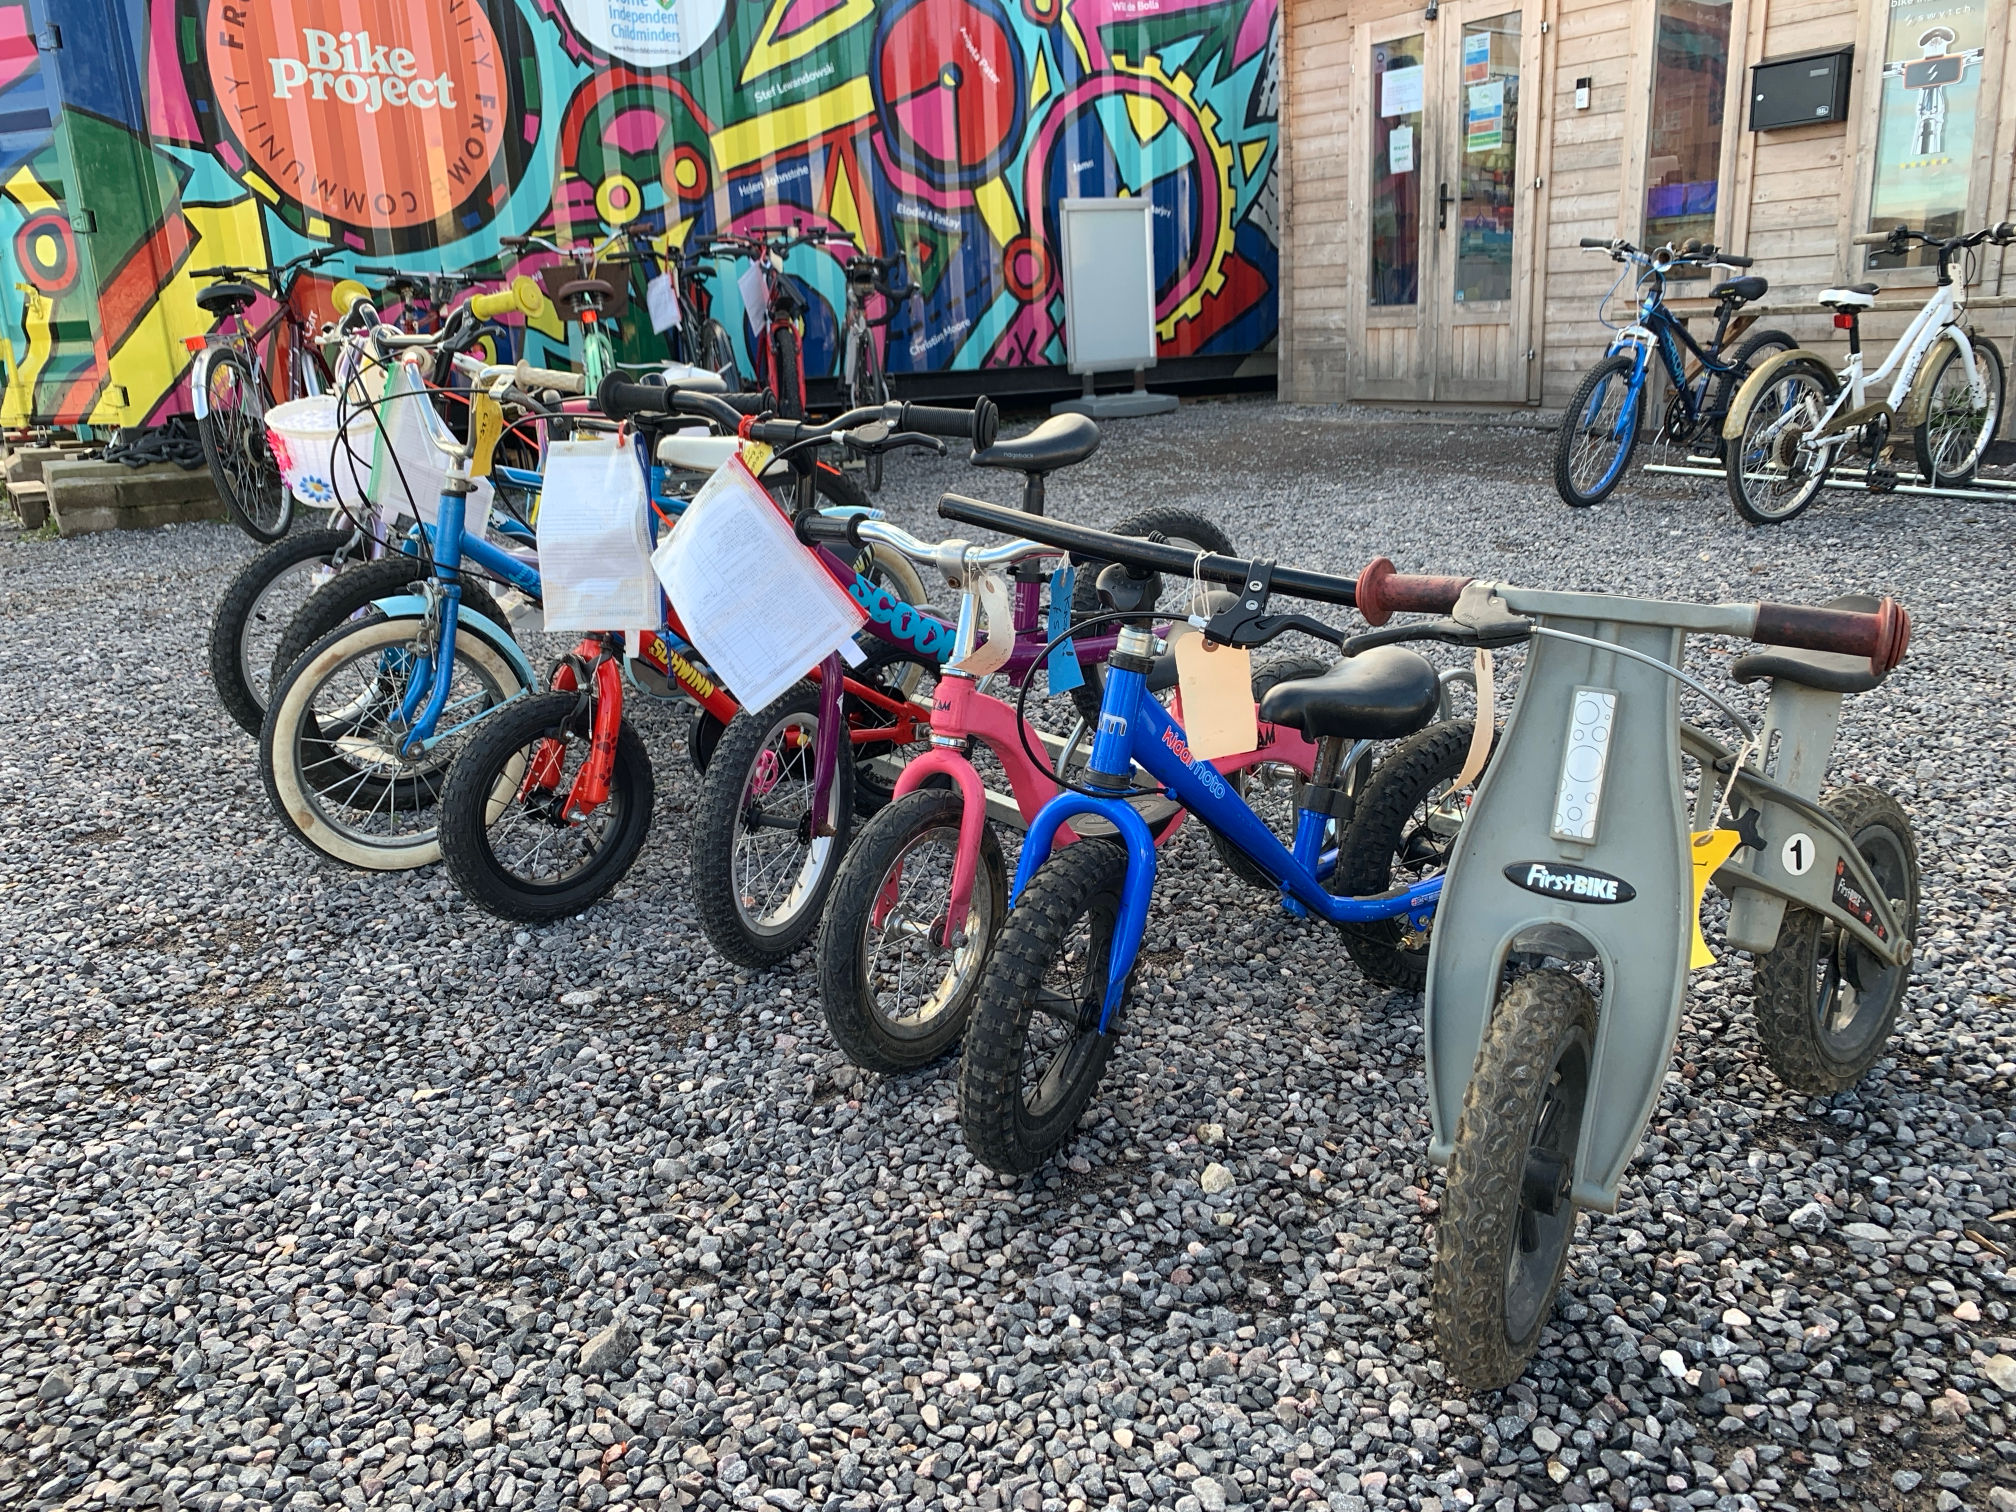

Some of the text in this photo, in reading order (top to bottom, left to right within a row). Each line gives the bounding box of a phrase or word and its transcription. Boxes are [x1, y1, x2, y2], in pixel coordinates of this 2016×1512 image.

[608, 6, 679, 25] Independent
[611, 23, 681, 43] Childminders
[303, 28, 417, 77] Bike
[268, 58, 457, 113] Project
[754, 85, 776, 103] Stef
[738, 180, 765, 197] Helen
[896, 202, 927, 219] Elodie
[934, 212, 960, 230] Finlay
[942, 318, 971, 337] Moore
[649, 637, 715, 699] SCHWINN
[1790, 839, 1802, 871] 1
[1526, 863, 1619, 901] FirstBIKE
